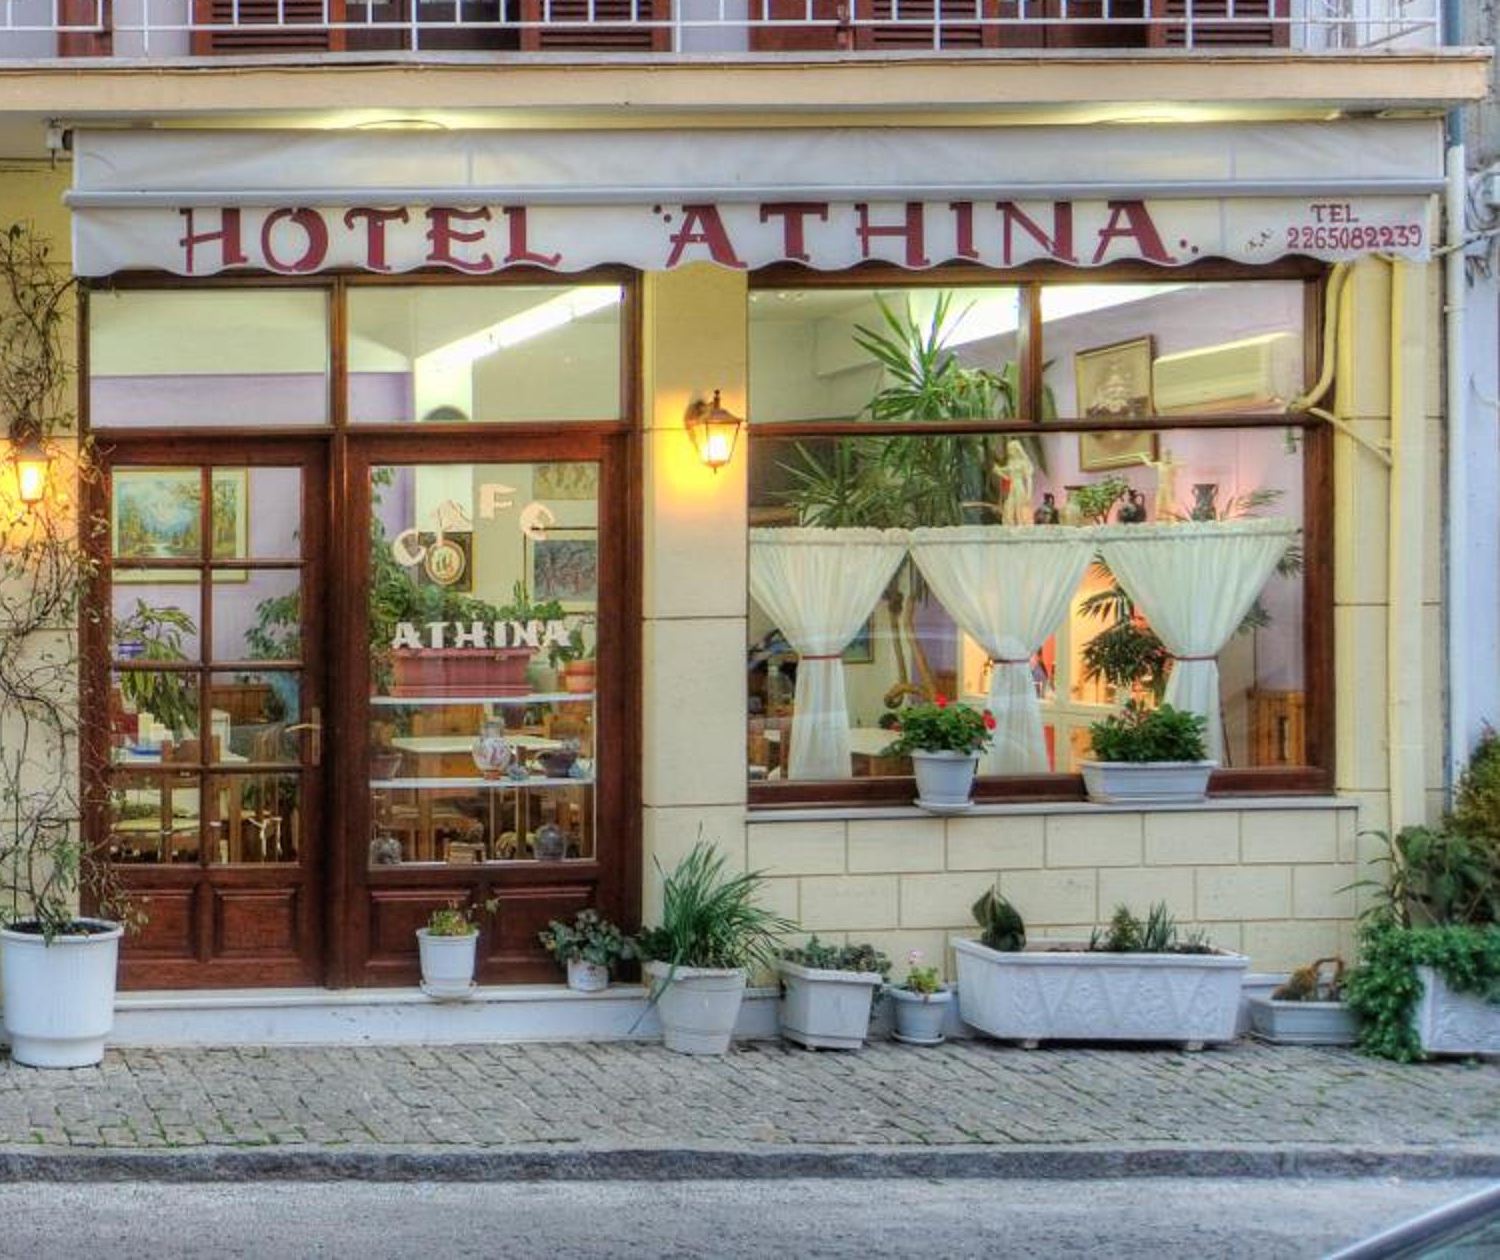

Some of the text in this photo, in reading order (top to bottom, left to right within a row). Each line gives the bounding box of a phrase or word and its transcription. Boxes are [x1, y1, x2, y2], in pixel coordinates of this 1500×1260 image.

[1311, 204, 1359, 223] TEL
[179, 201, 1178, 274] HOTEL ATHINA
[1287, 225, 1423, 250] 2265082239
[391, 620, 572, 650] ATHINA
